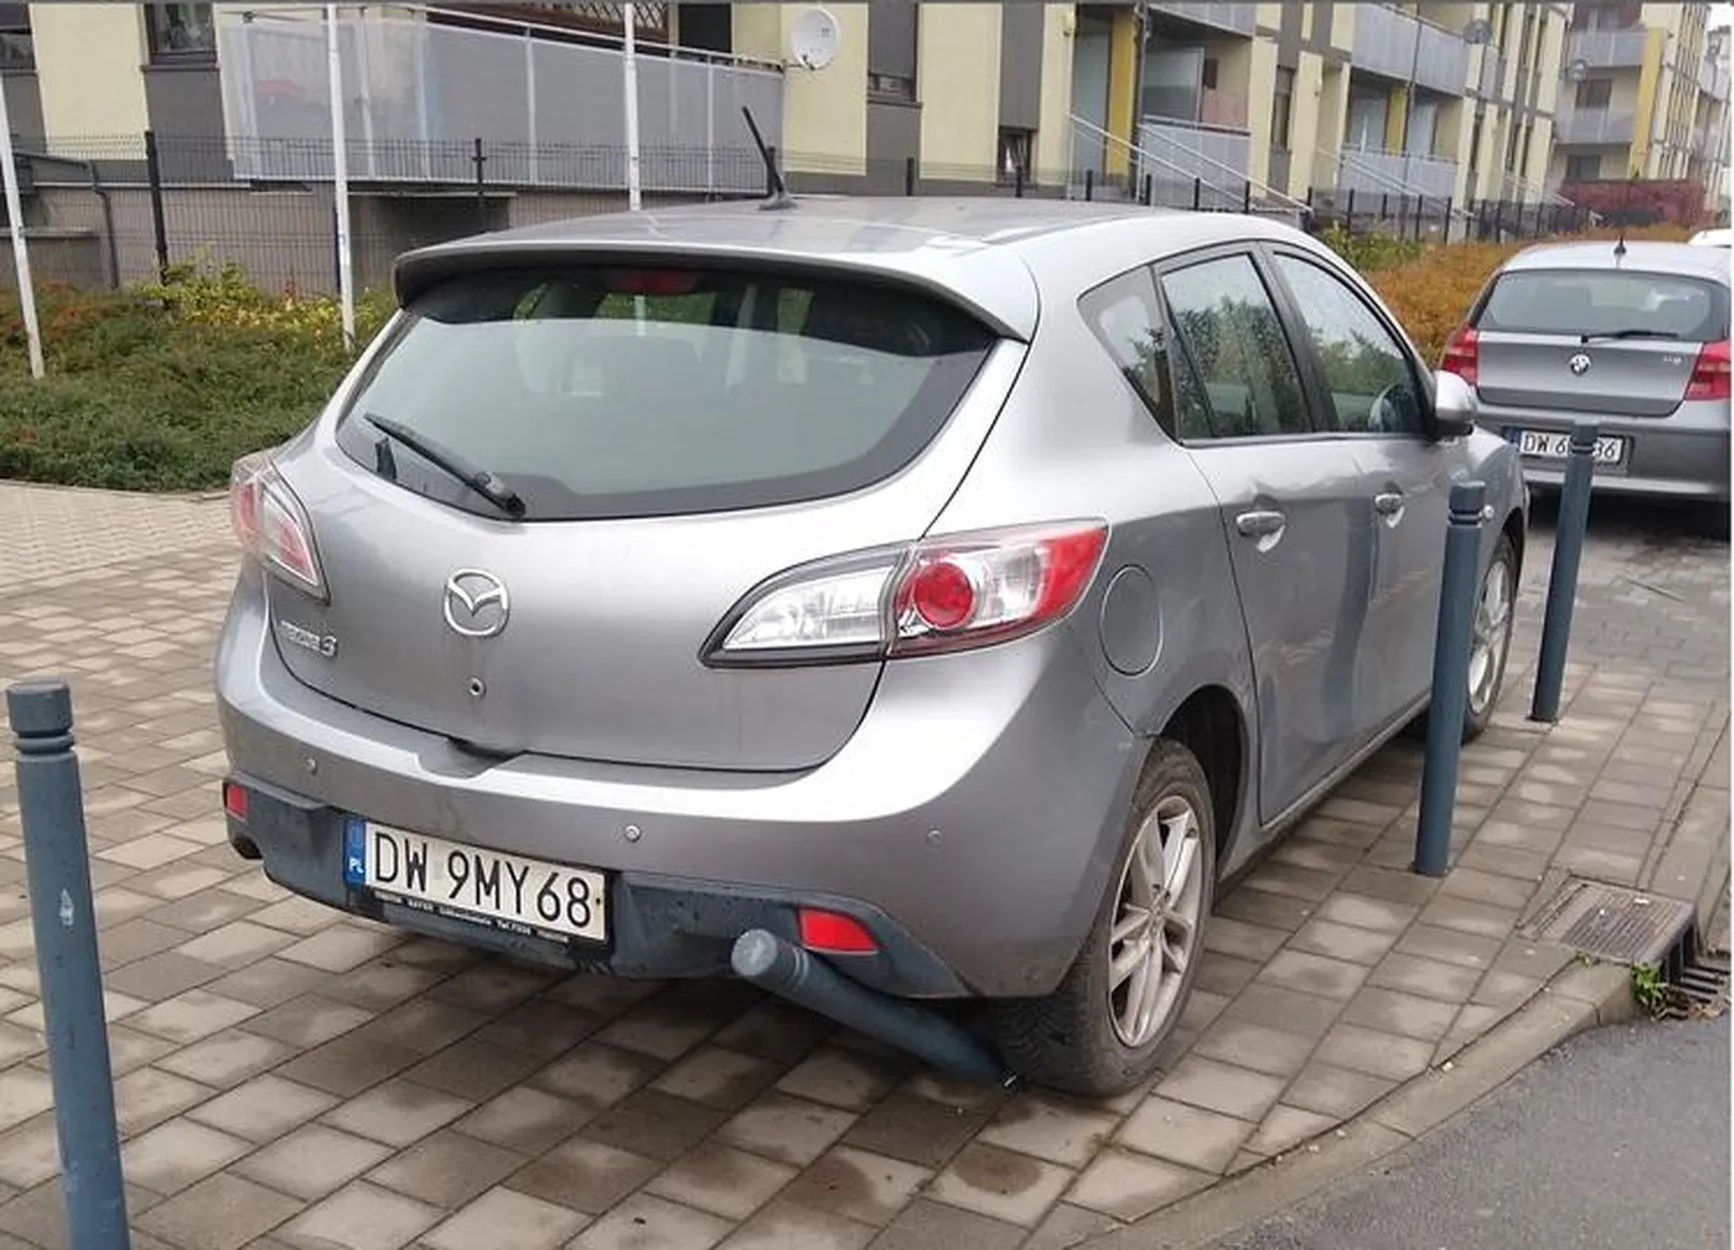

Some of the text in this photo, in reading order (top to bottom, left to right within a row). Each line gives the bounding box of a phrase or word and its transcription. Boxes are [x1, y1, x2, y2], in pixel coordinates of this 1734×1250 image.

[1524, 434, 1550, 453] DW
[349, 857, 364, 874] PL
[375, 831, 592, 928] DW 9MY68
